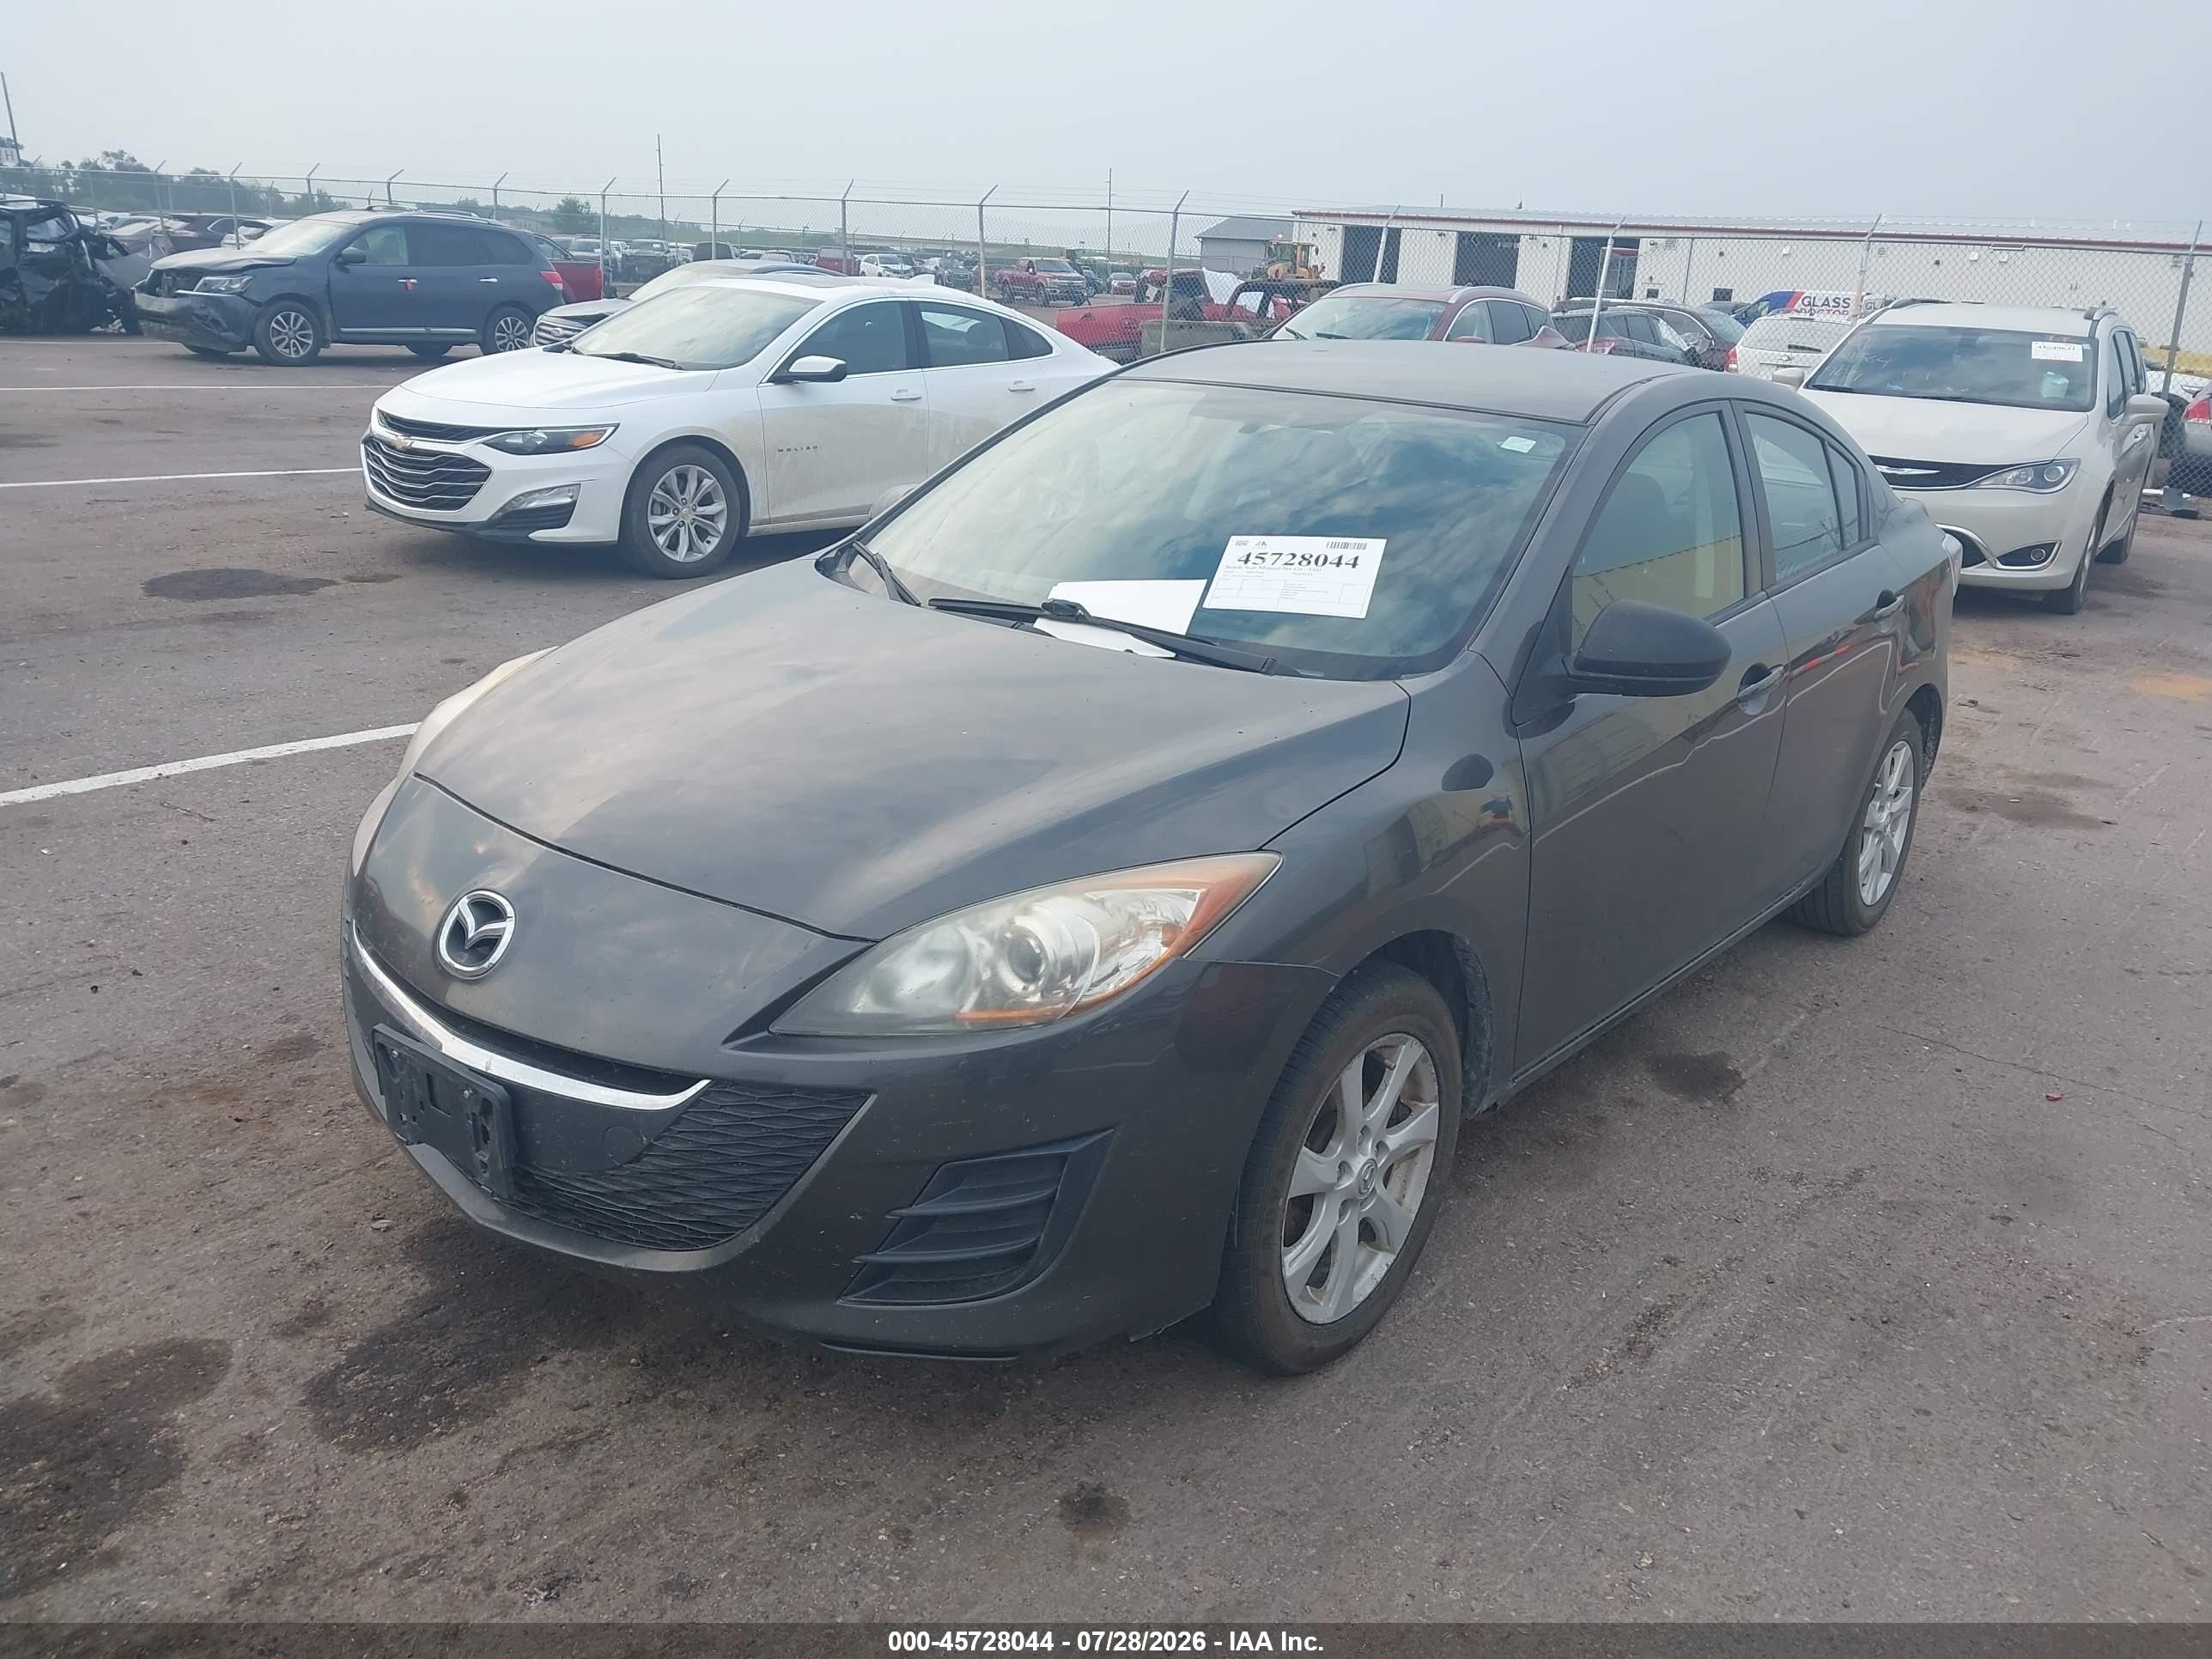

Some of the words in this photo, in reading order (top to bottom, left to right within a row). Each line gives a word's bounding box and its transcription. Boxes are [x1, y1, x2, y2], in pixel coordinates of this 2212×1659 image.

[1802, 295, 1851, 308] GLASS
[1865, 301, 1885, 310] GLA
[1237, 552, 1359, 568] 45728044
